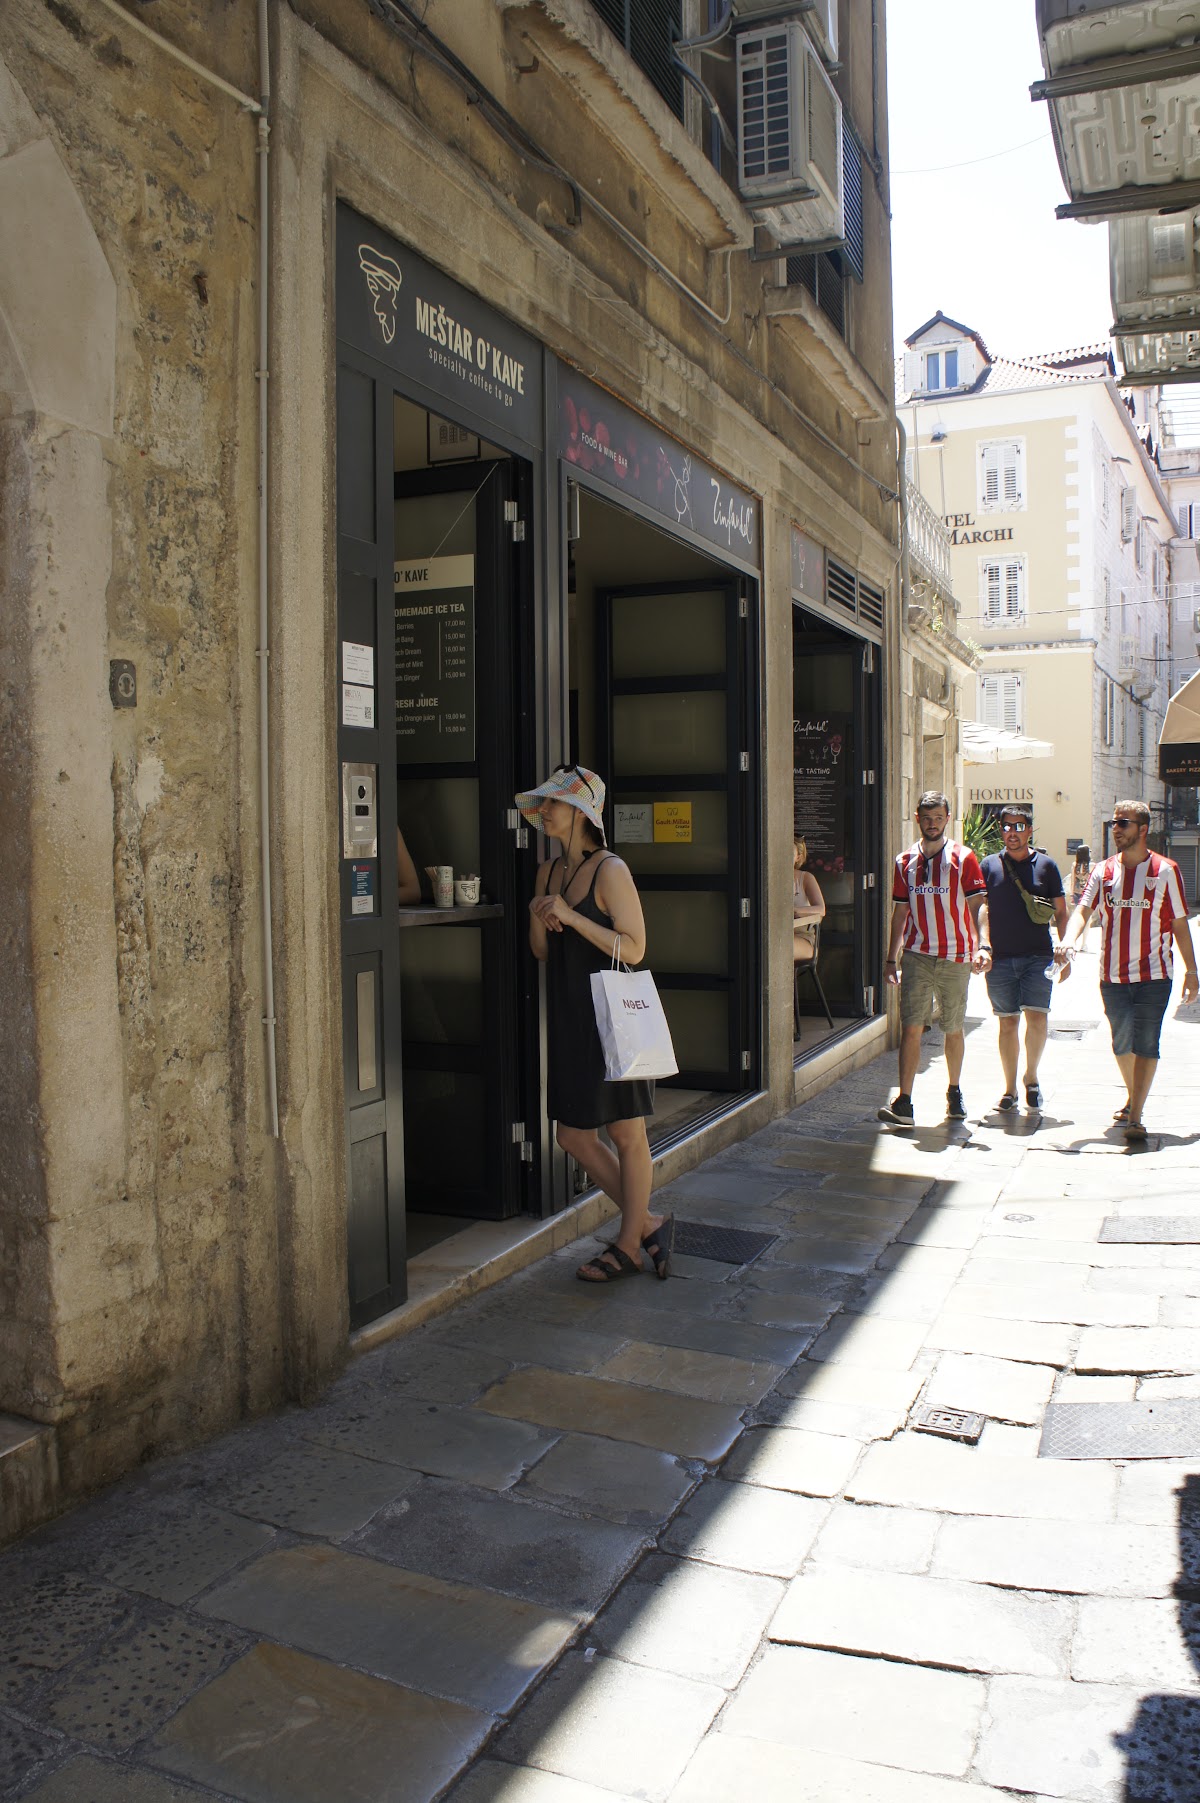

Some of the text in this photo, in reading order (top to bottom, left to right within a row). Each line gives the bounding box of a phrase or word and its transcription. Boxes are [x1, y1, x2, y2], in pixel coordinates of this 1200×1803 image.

[416, 296, 472, 363] MEŠTAR
[492, 346, 524, 395] KAVE
[428, 346, 513, 406] specialty coffee to go
[581, 432, 628, 468] FOOD & WINE BAR
[941, 513, 975, 527] TEL
[405, 568, 428, 583] KAVE
[395, 603, 465, 618] OMEMADE ICE TEA
[395, 697, 439, 709] RESH JUICE
[970, 788, 1034, 801] HORTUS
[909, 886, 950, 894] Petronor
